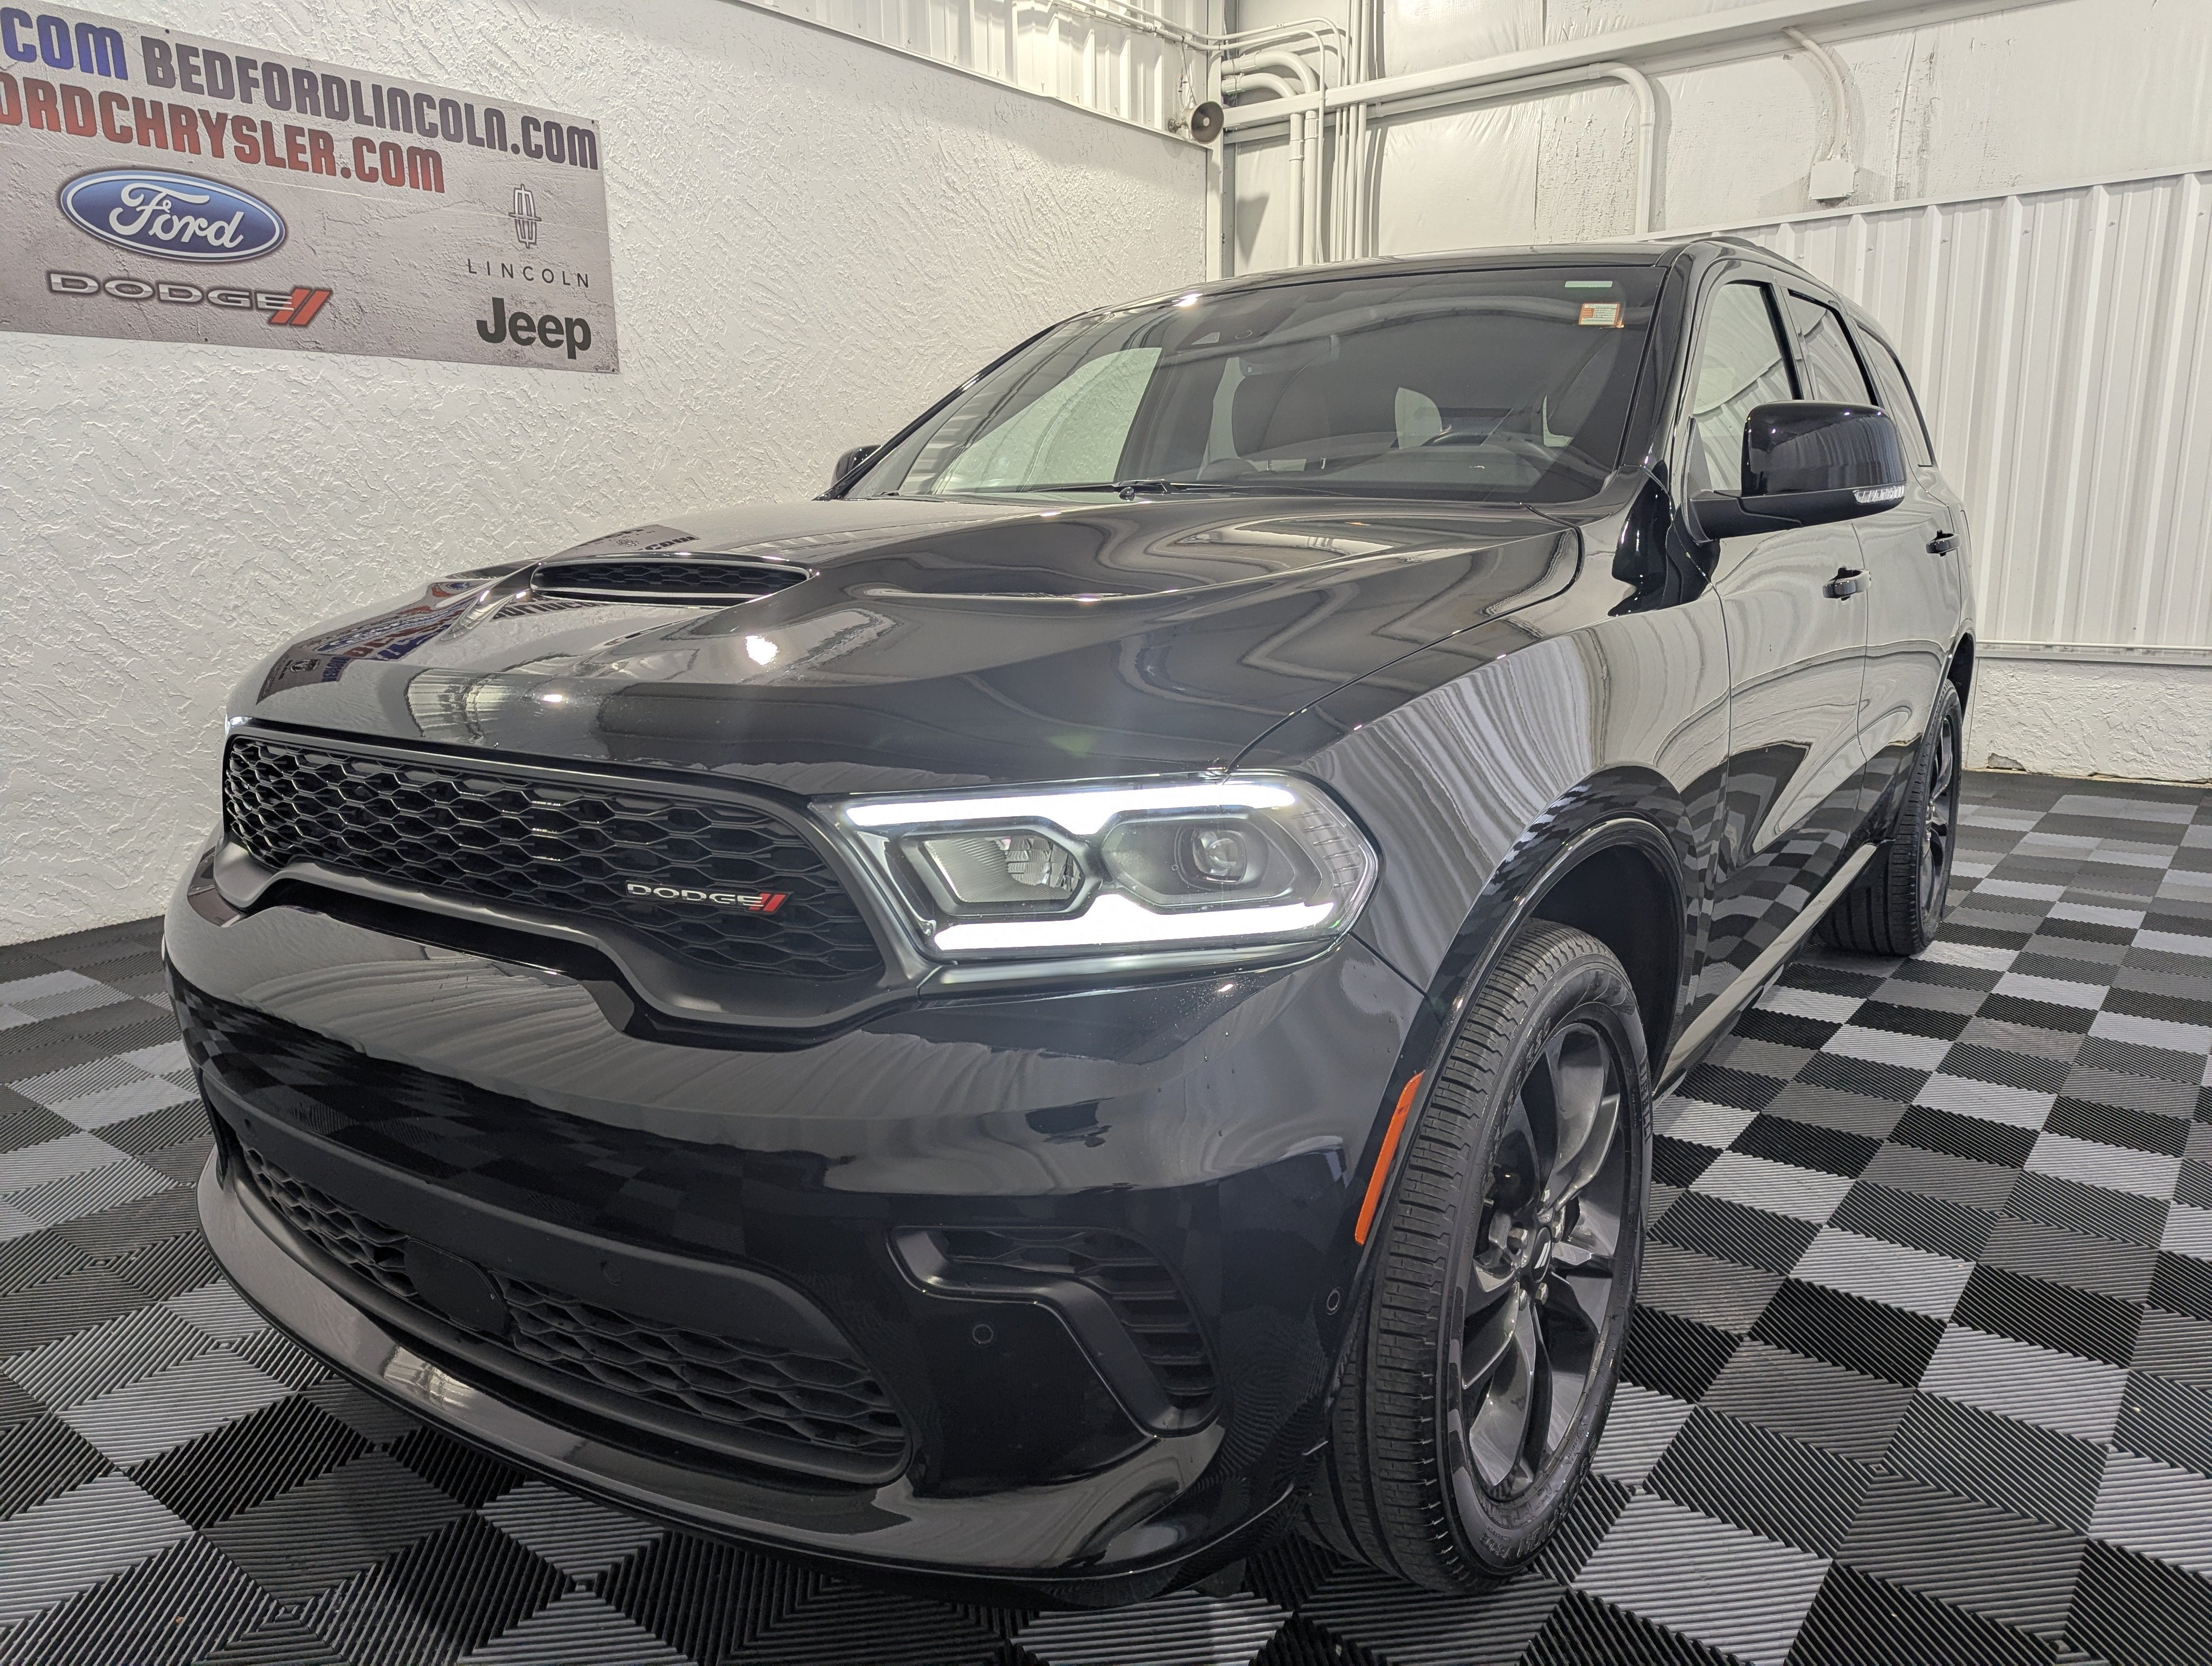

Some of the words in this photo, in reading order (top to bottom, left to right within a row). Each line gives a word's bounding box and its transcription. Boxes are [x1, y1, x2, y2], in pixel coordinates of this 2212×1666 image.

[0, 7, 128, 80] COM
[140, 36, 599, 170] BEDFORDLINCOLN.COM
[109, 182, 246, 250] Ford
[50, 274, 294, 312] DODGE
[467, 258, 589, 289] LINCOLN
[476, 297, 592, 360] Jeep
[627, 883, 763, 907] DODGE
